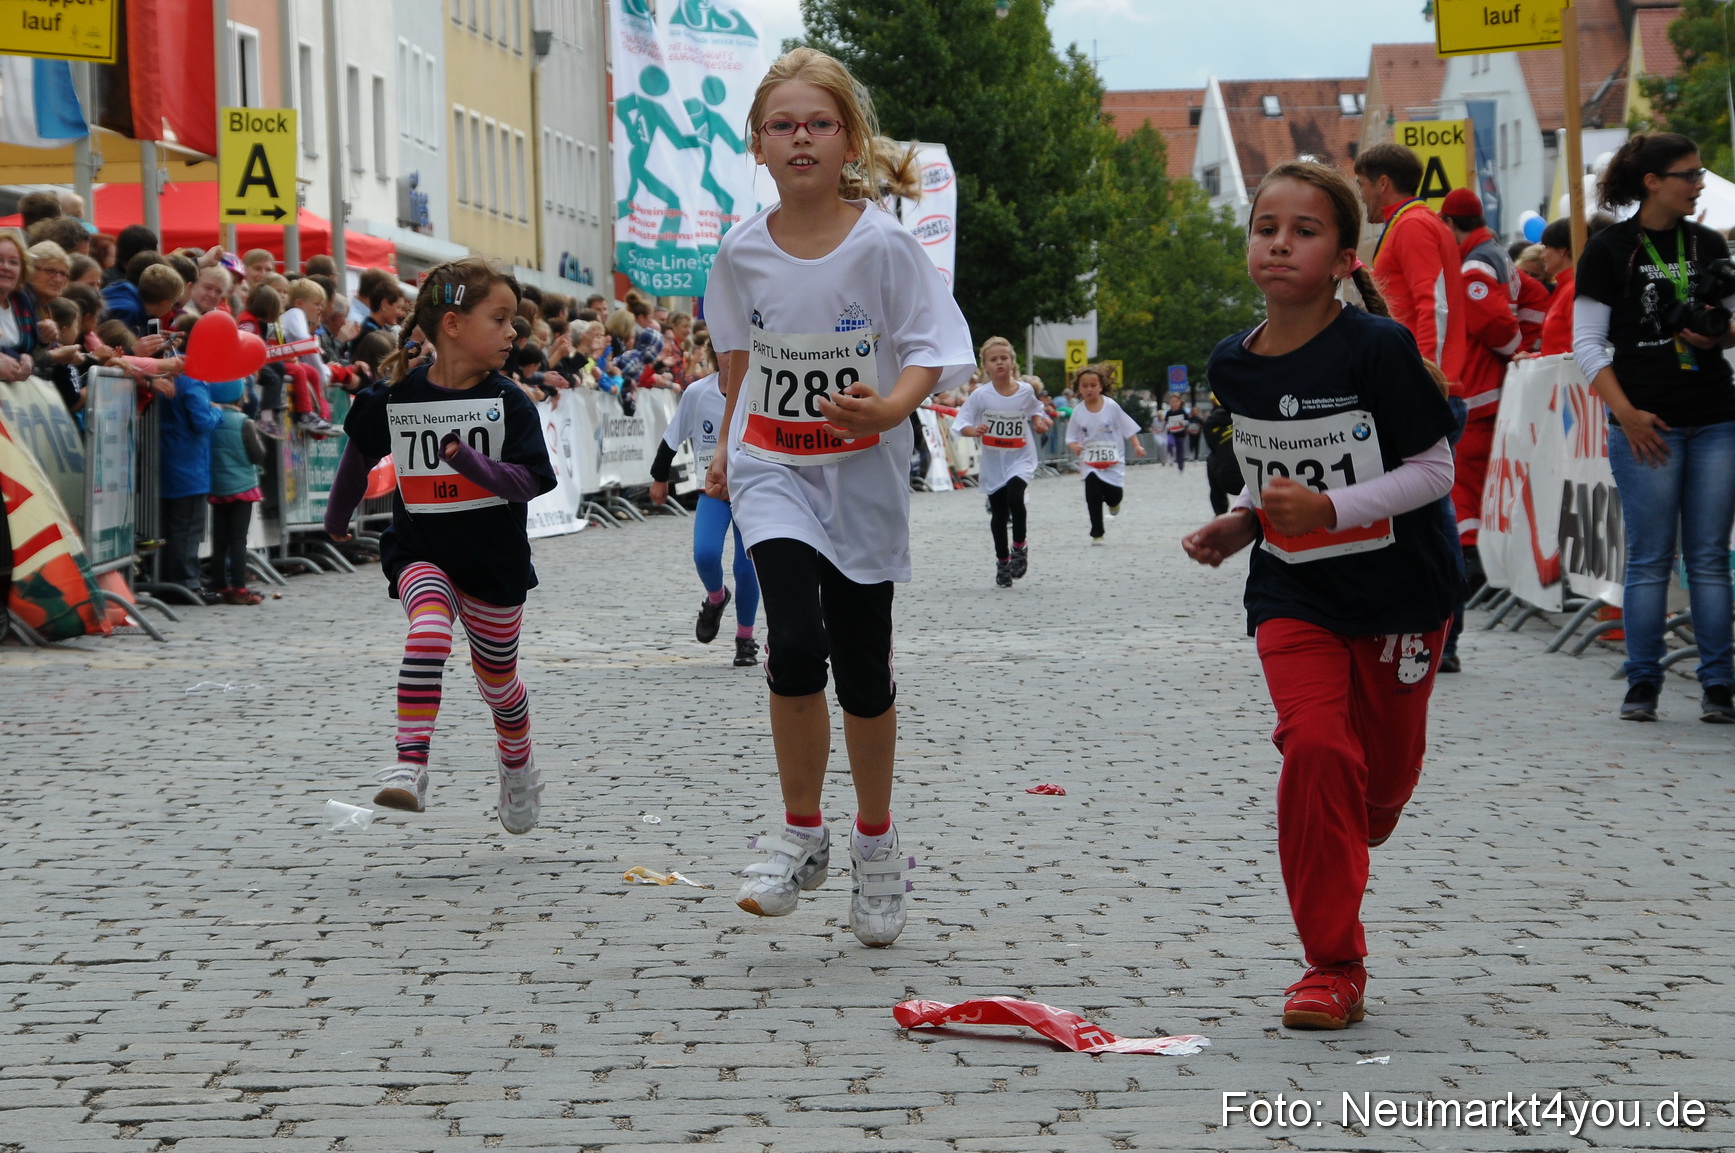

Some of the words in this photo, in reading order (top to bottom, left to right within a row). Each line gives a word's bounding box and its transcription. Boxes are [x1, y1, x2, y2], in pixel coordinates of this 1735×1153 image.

[22, 10, 62, 31] lauf
[1484, 4, 1521, 25] lauf
[229, 112, 287, 133] Block
[1404, 125, 1465, 147] Block
[236, 143, 279, 198] A
[1420, 156, 1453, 198] A
[652, 273, 692, 289] 6352
[753, 340, 778, 359] PARTL
[780, 347, 850, 360] Neumarkt
[1070, 348, 1082, 364] C
[390, 415, 421, 425] PARTL
[423, 411, 482, 424] Neumarkt
[987, 419, 1023, 436] 7036
[400, 426, 490, 470] 700
[775, 427, 842, 450] Aurelia
[1235, 429, 1267, 449] PARTL
[1269, 431, 1346, 450] Neumarkt
[1089, 449, 1115, 461] 7158
[433, 481, 459, 499] Ida
